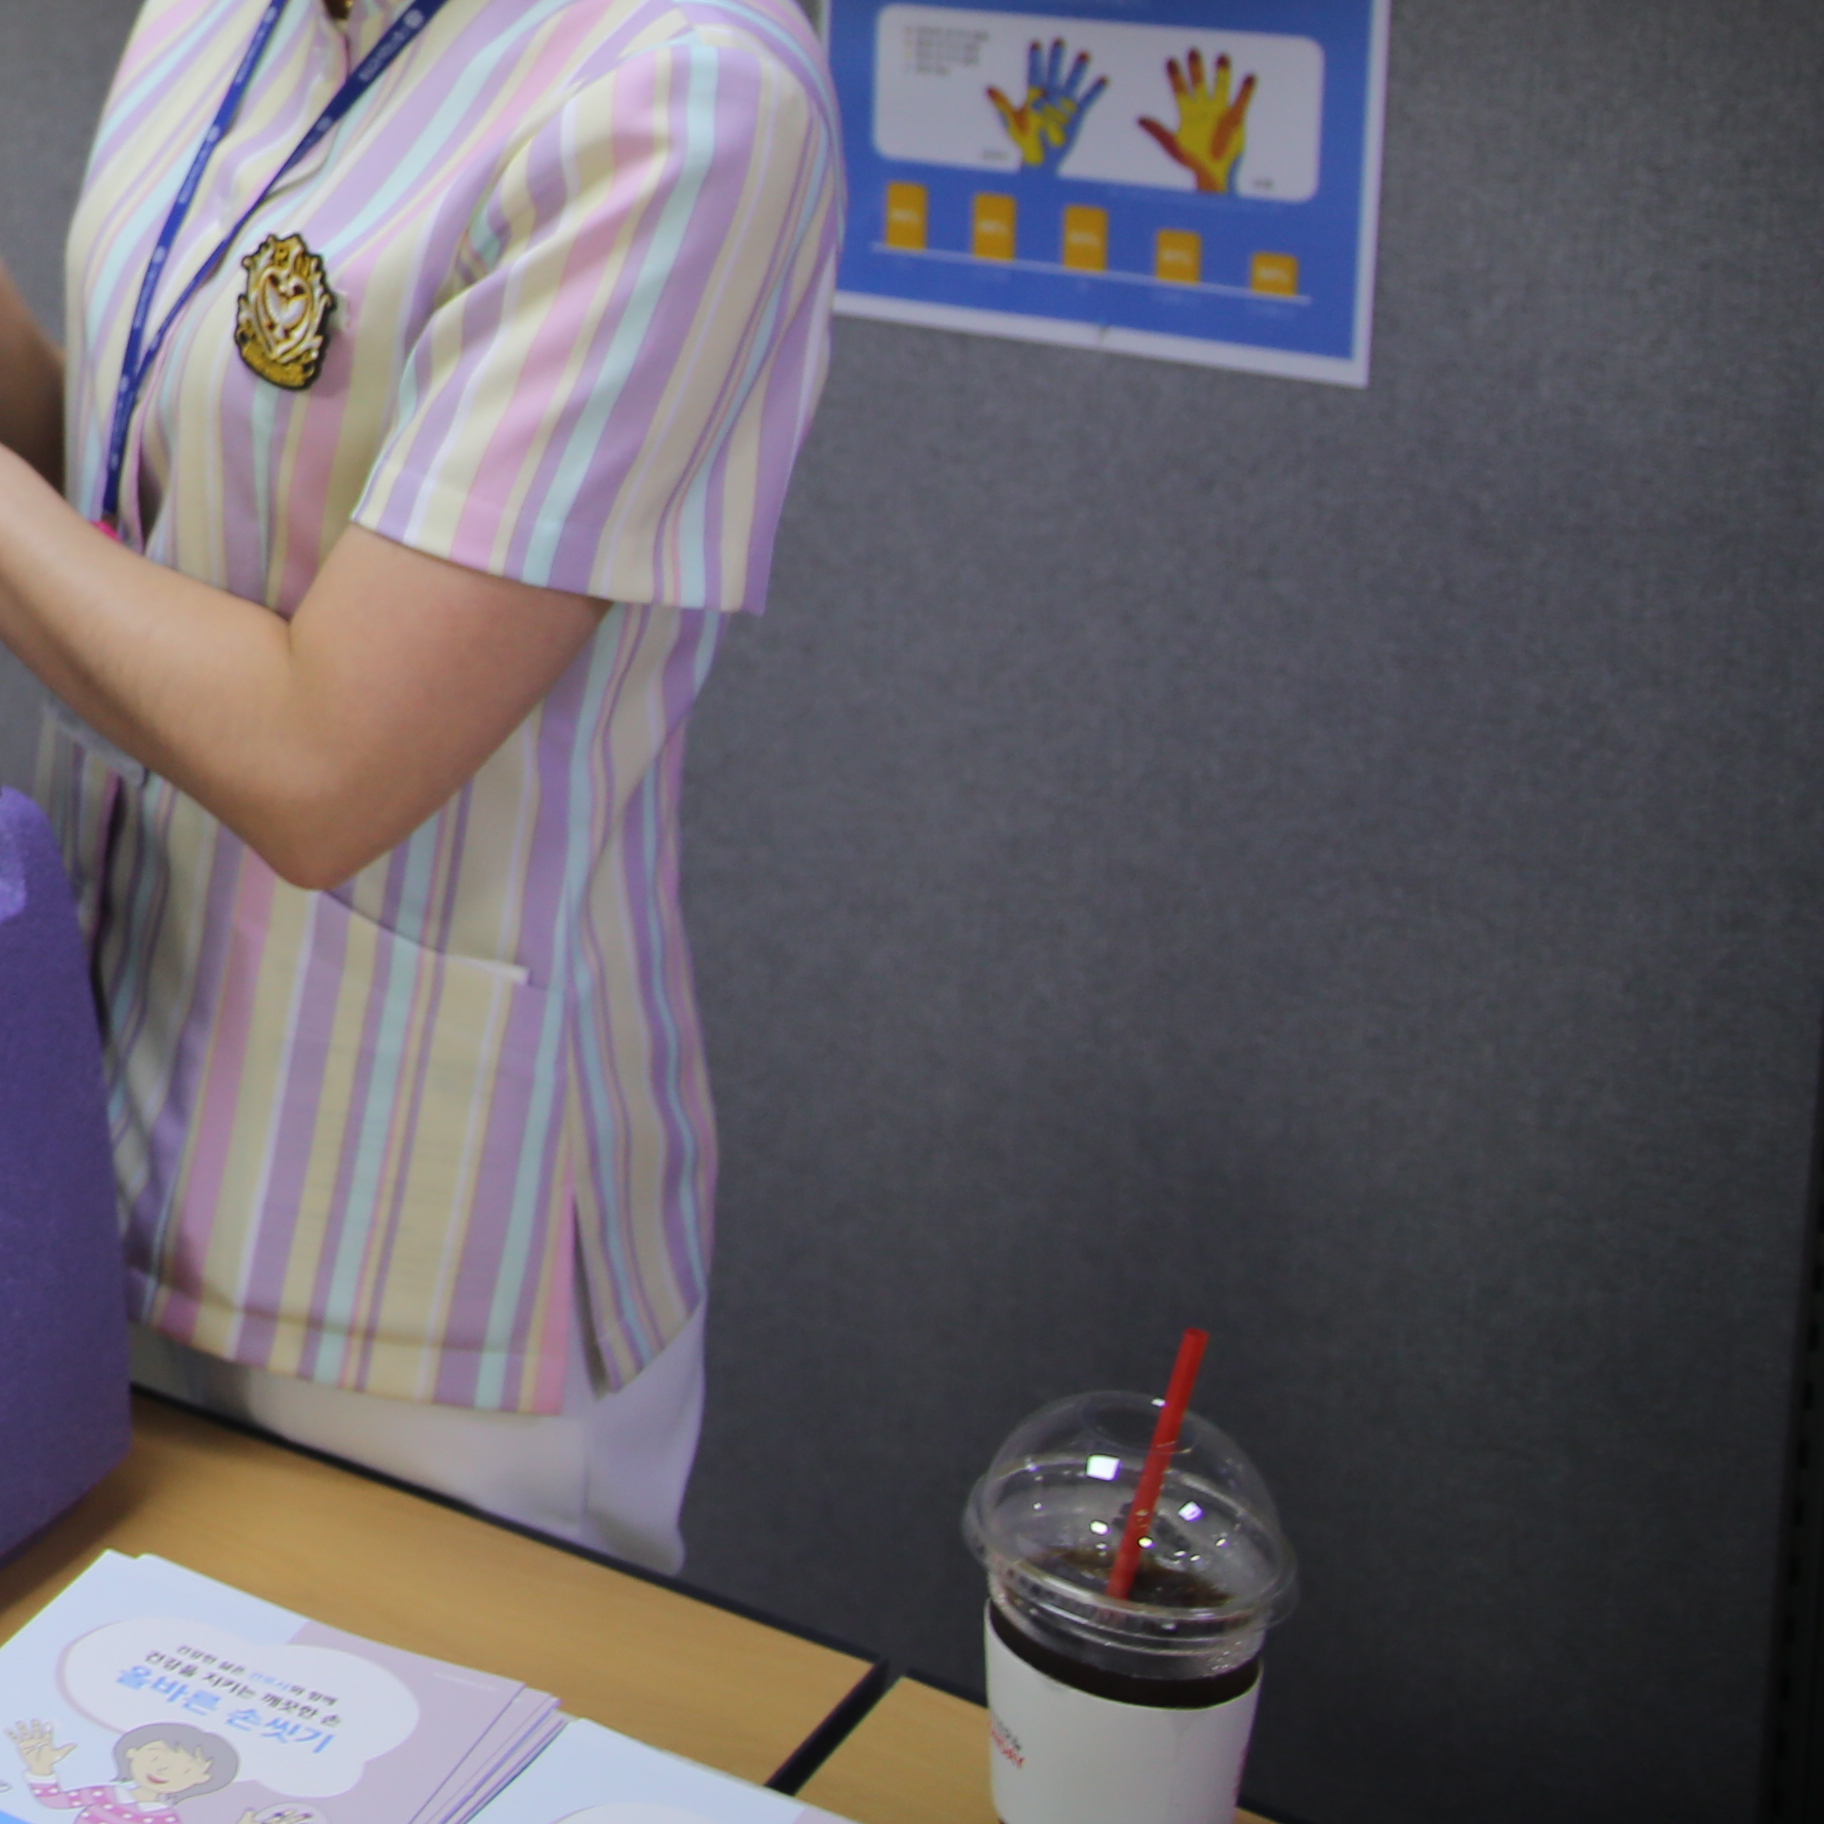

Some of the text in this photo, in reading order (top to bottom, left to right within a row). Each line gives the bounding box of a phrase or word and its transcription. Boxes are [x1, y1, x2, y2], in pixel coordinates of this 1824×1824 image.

[115, 1665, 335, 1755] 올바른 손씻기
[145, 1650, 199, 1678] 건강을
[203, 1672, 257, 1699] 지키는
[261, 1692, 319, 1719] 깨끗한
